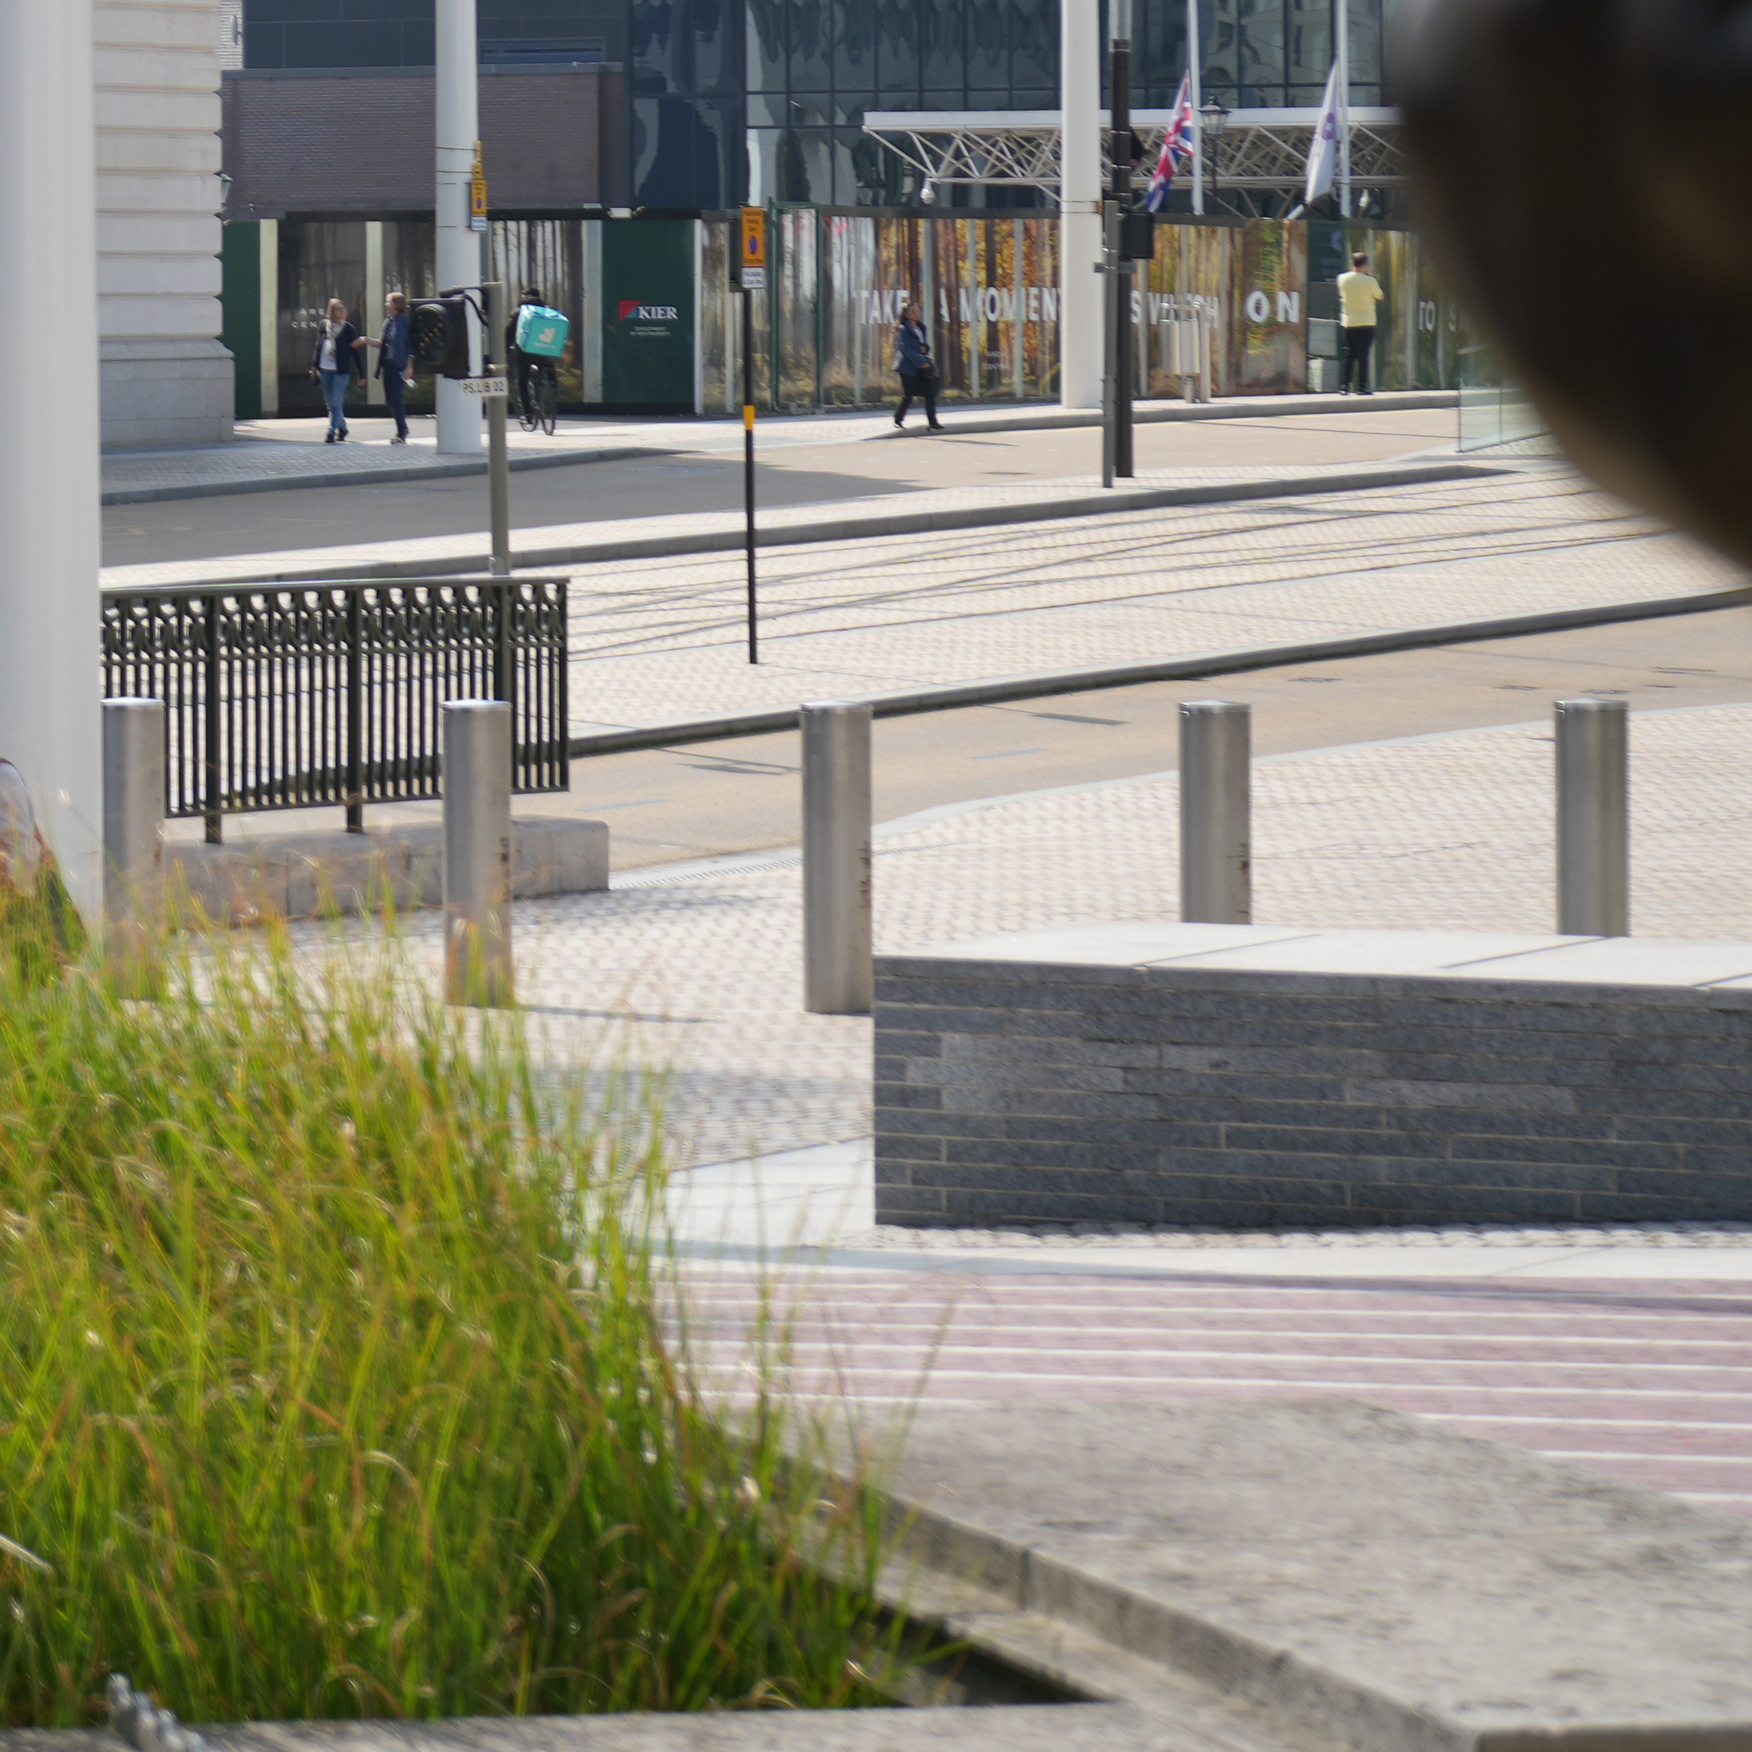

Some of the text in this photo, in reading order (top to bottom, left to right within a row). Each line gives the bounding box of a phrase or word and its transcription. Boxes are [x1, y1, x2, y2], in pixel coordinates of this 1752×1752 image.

[959, 286, 1063, 322] MOMEN
[1246, 290, 1300, 323] ON
[637, 305, 679, 320] KIER
[493, 380, 505, 392] 02
